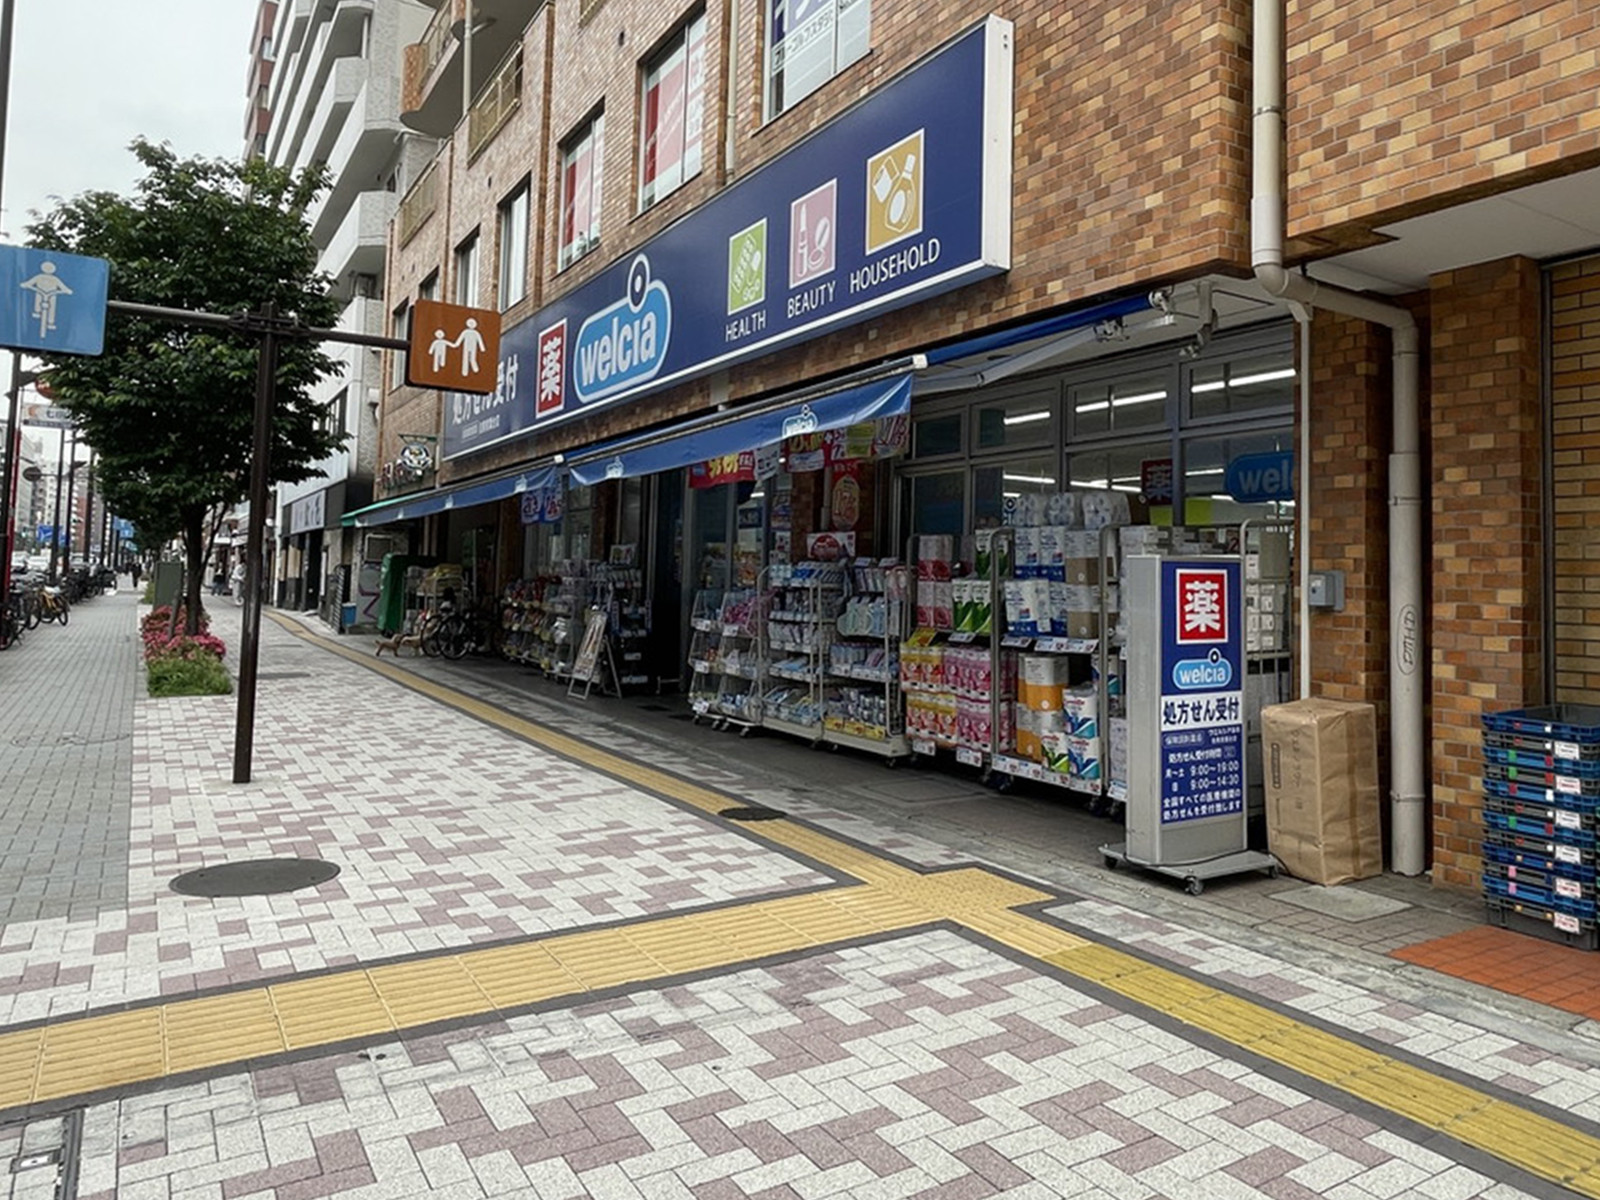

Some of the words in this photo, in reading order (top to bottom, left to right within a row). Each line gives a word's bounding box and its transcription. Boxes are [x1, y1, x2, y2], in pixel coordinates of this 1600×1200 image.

[849, 237, 941, 294] HOUSEHOLD
[787, 280, 836, 318] BEAUTY
[725, 310, 766, 342] HEALTH
[580, 310, 657, 388] welcia
[541, 336, 562, 401] 薬
[1238, 459, 1295, 493] wel
[1184, 580, 1221, 633] 薬
[1179, 665, 1226, 684] welcia
[1163, 697, 1240, 725] 処方せん受付
